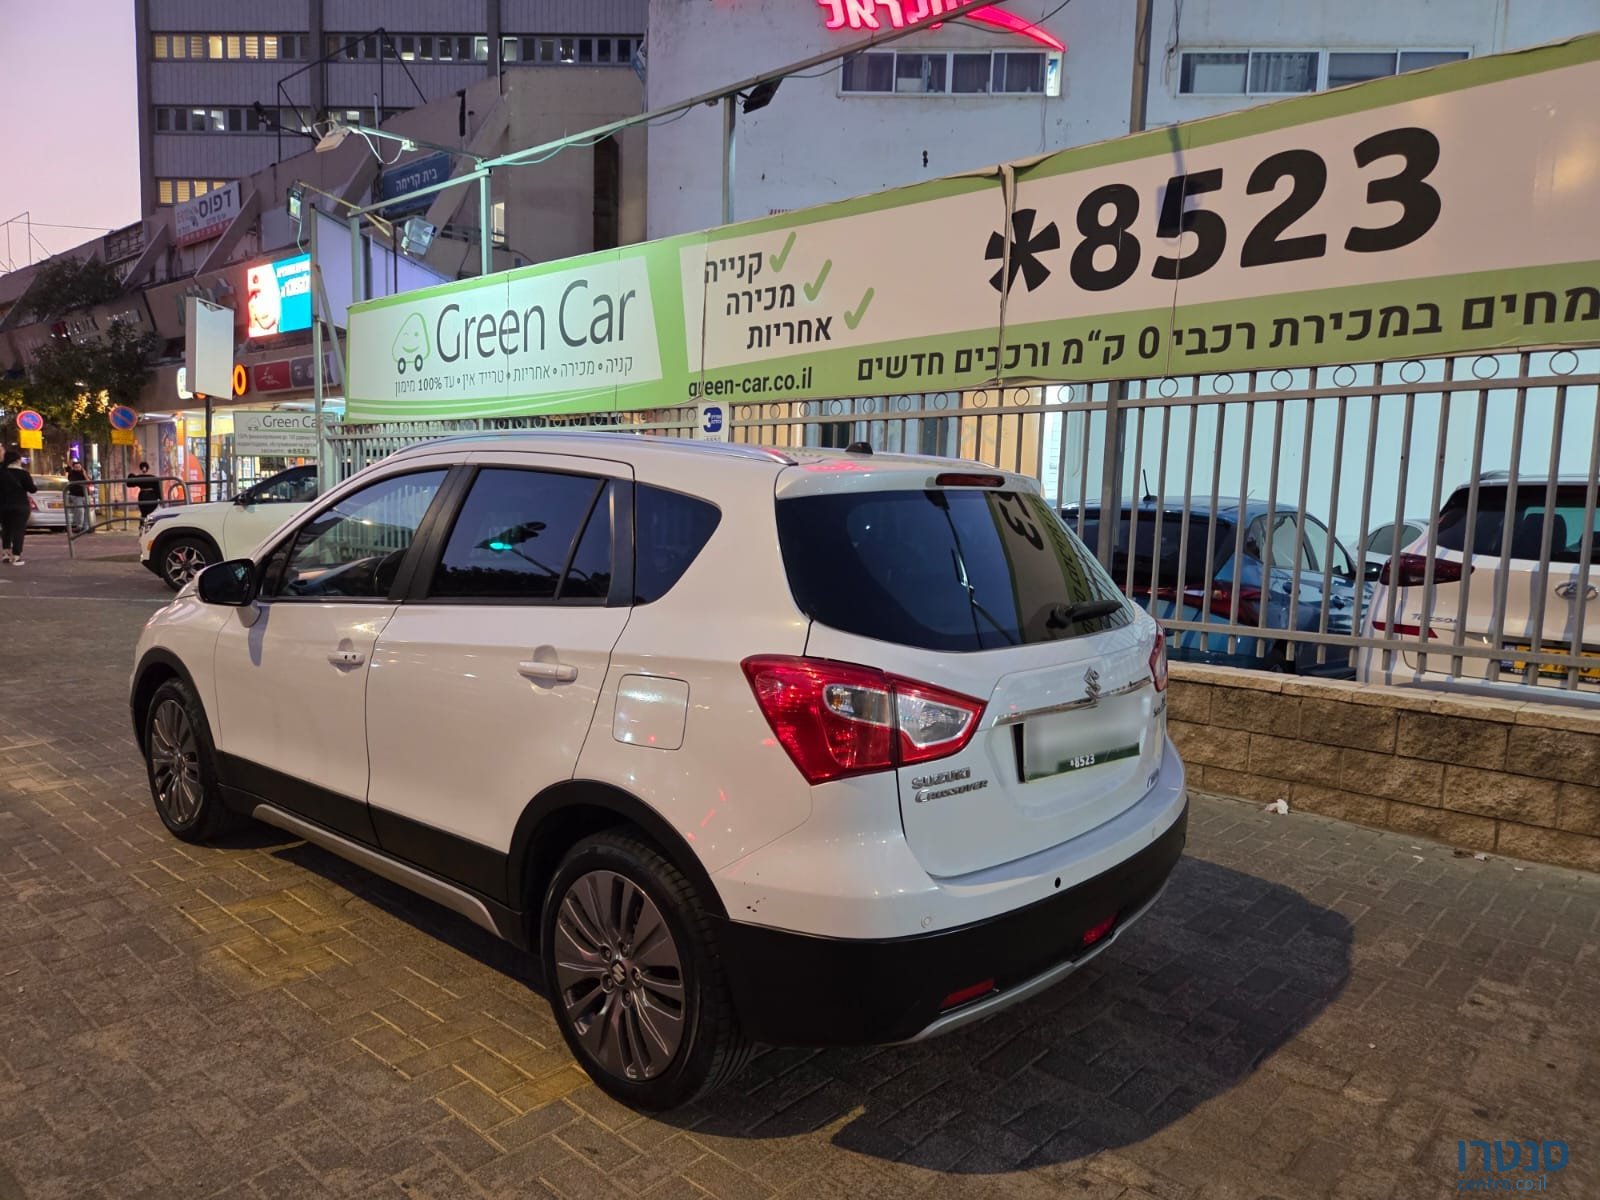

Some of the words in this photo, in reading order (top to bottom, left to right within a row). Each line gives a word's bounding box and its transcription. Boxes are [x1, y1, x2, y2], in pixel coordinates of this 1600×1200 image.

[423, 168, 438, 183] בית
[198, 189, 232, 219] דפוס
[704, 251, 763, 284] קנייה
[726, 283, 796, 316] מכירה
[436, 303, 546, 363] Green
[558, 279, 636, 348] Car
[746, 316, 833, 350] אחריות
[1268, 302, 1442, 348] במכירת
[1138, 326, 1160, 359] 0
[1172, 321, 1256, 356] רכבי
[560, 360, 596, 378] מכירה
[605, 356, 633, 377] קניה
[857, 351, 945, 381] חדשים
[954, 341, 1050, 374] ורכבים
[418, 376, 442, 392] 100%
[443, 375, 456, 389] עד
[462, 372, 476, 391] אין
[512, 364, 551, 383] אחריות
[394, 379, 416, 398] מימון
[262, 414, 299, 429] Green
[911, 766, 971, 789] SUZUKI
